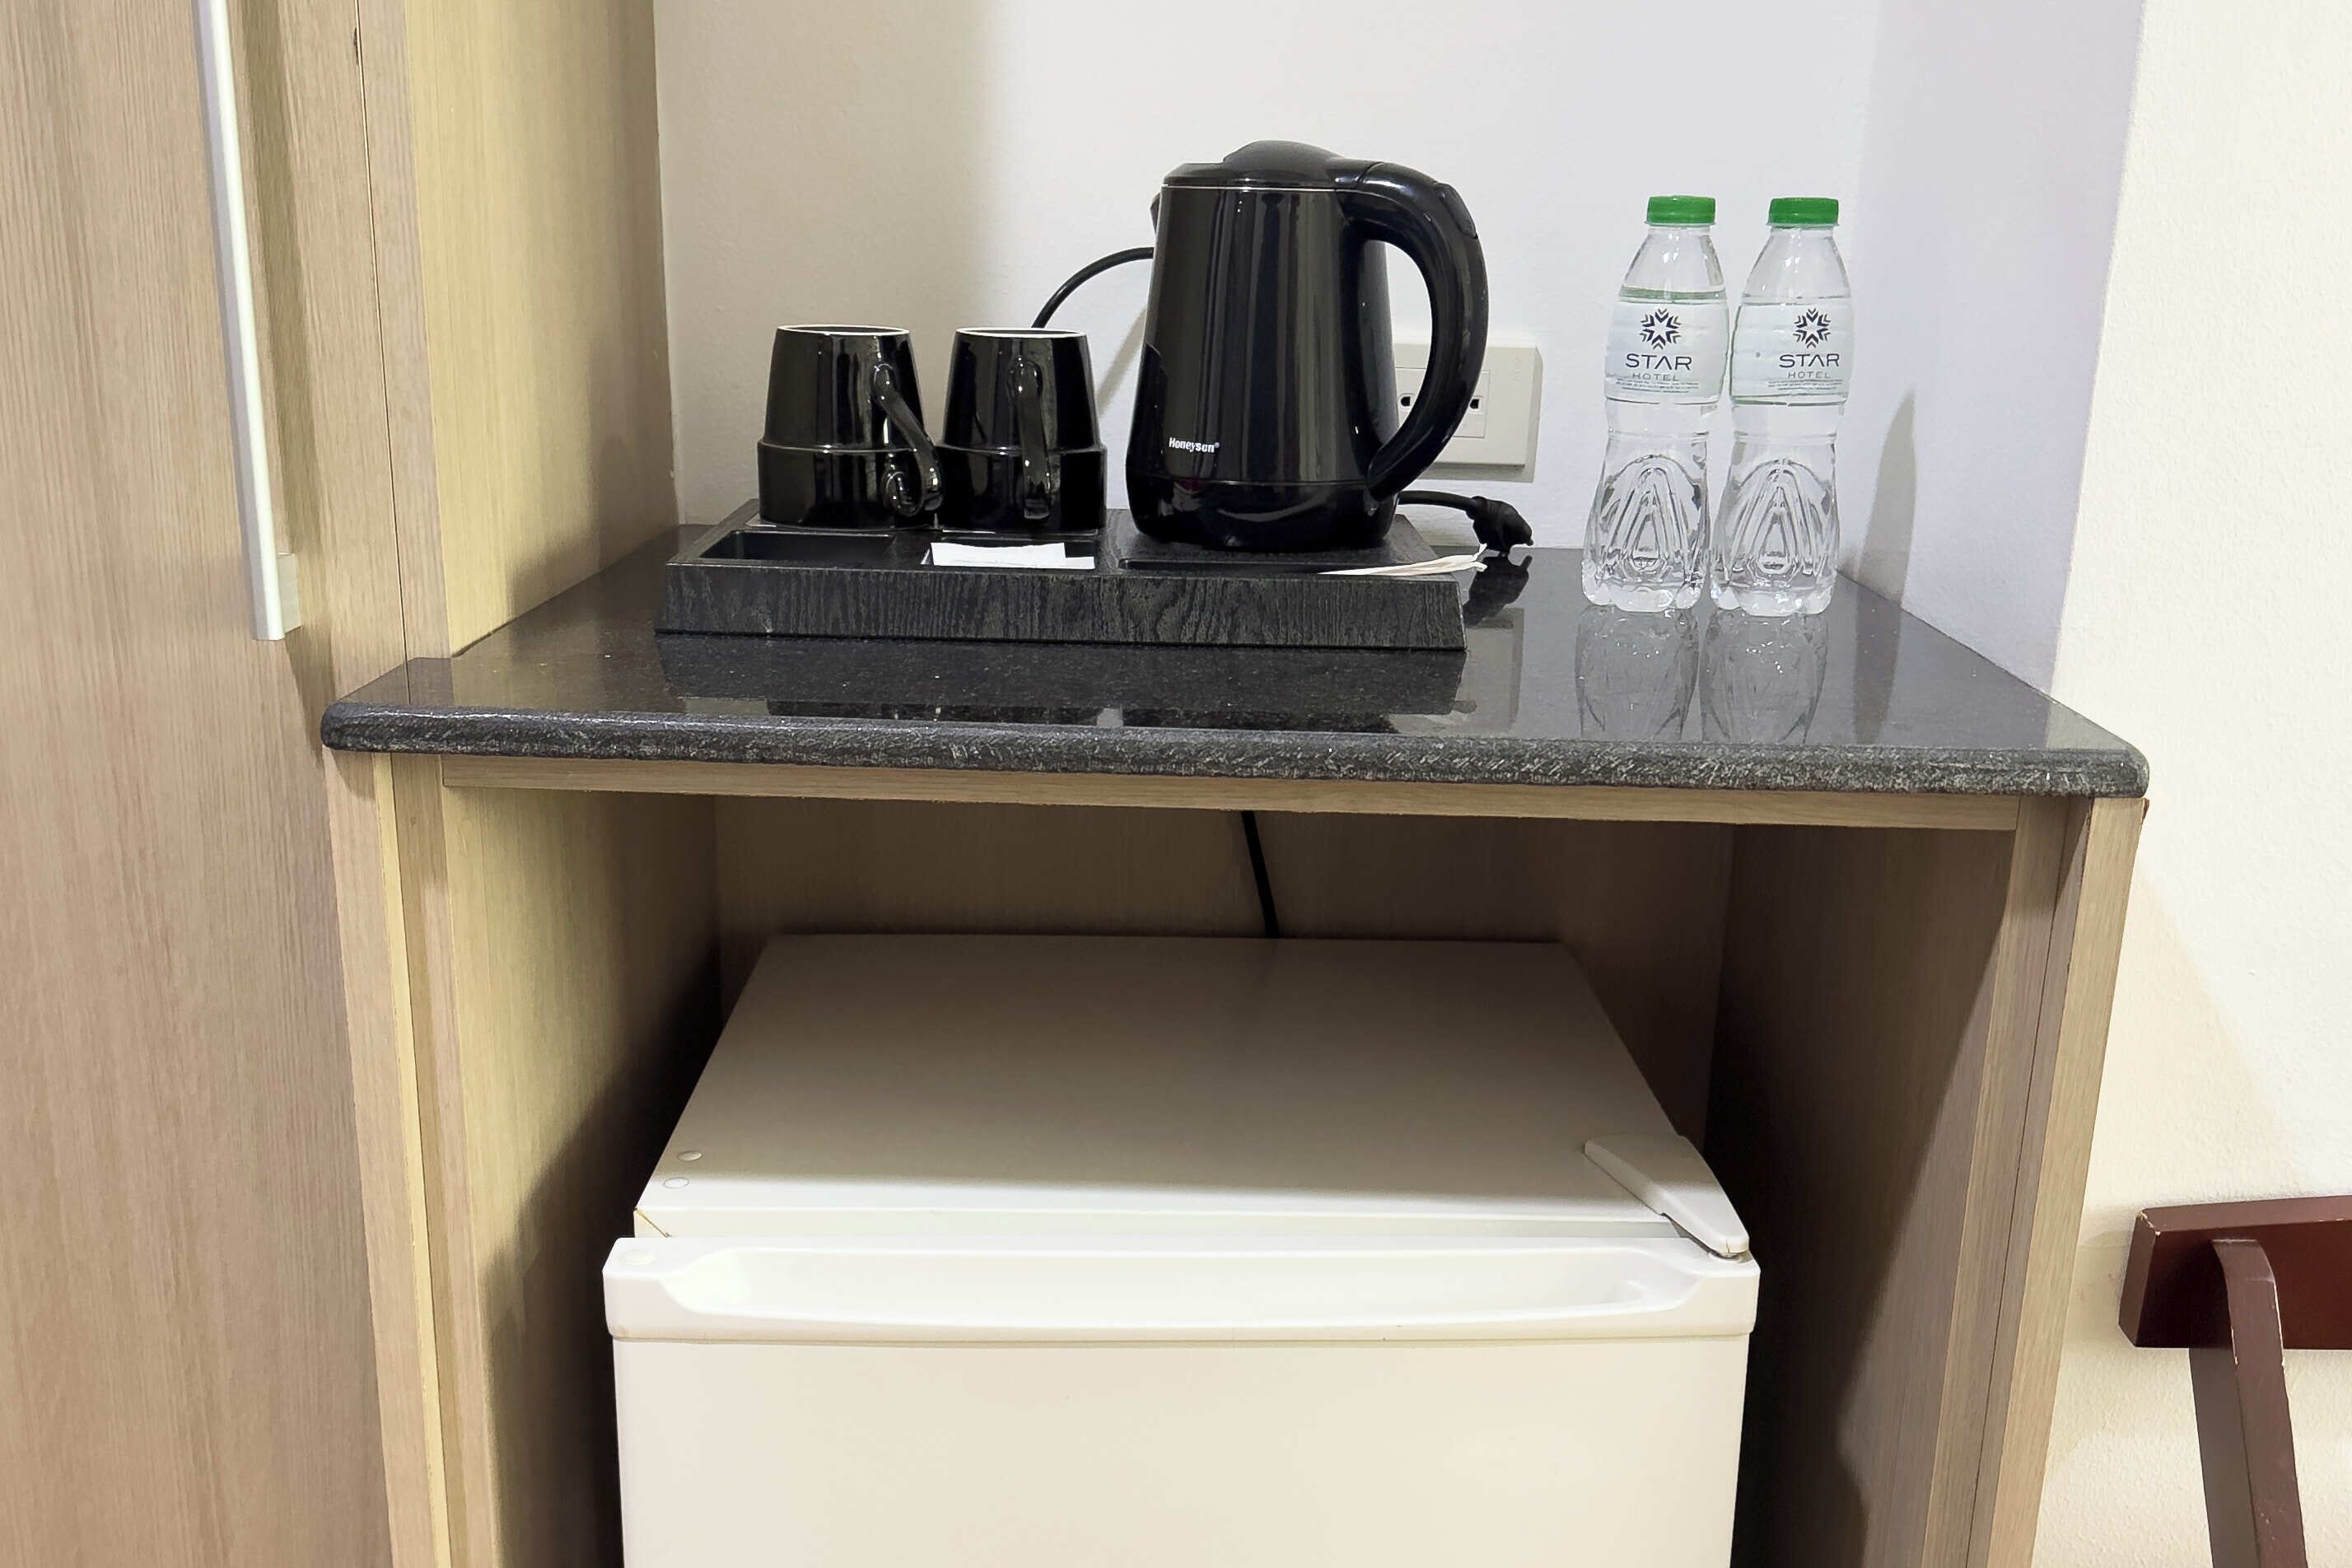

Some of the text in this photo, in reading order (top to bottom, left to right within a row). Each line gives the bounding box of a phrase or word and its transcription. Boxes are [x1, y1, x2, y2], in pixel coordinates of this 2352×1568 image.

[1625, 352, 1692, 371] STAR
[1779, 352, 1840, 368] STAR
[1632, 372, 1680, 381] HOTEL
[1787, 371, 1832, 379] HOTEL
